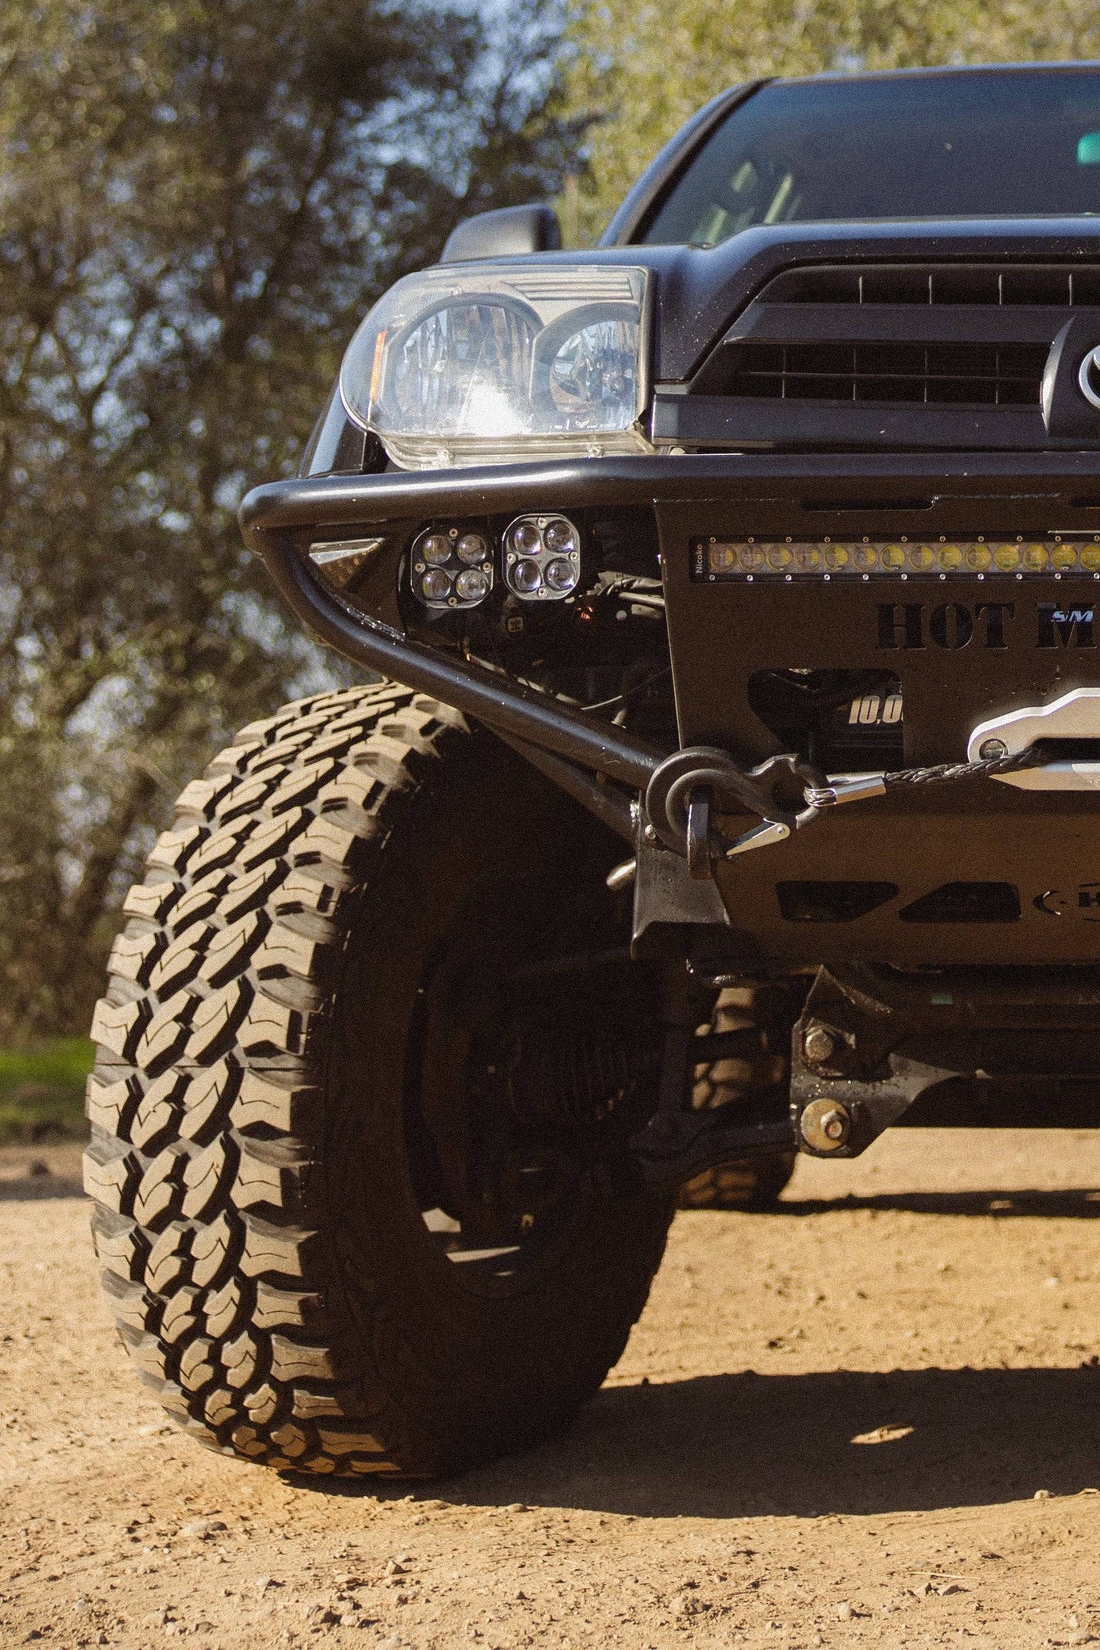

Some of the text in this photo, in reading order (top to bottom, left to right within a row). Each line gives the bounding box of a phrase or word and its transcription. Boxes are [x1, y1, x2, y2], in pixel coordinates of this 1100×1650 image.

[695, 544, 703, 574] Nicoko
[874, 602, 1016, 650] HOT
[848, 694, 903, 725] 10,0
